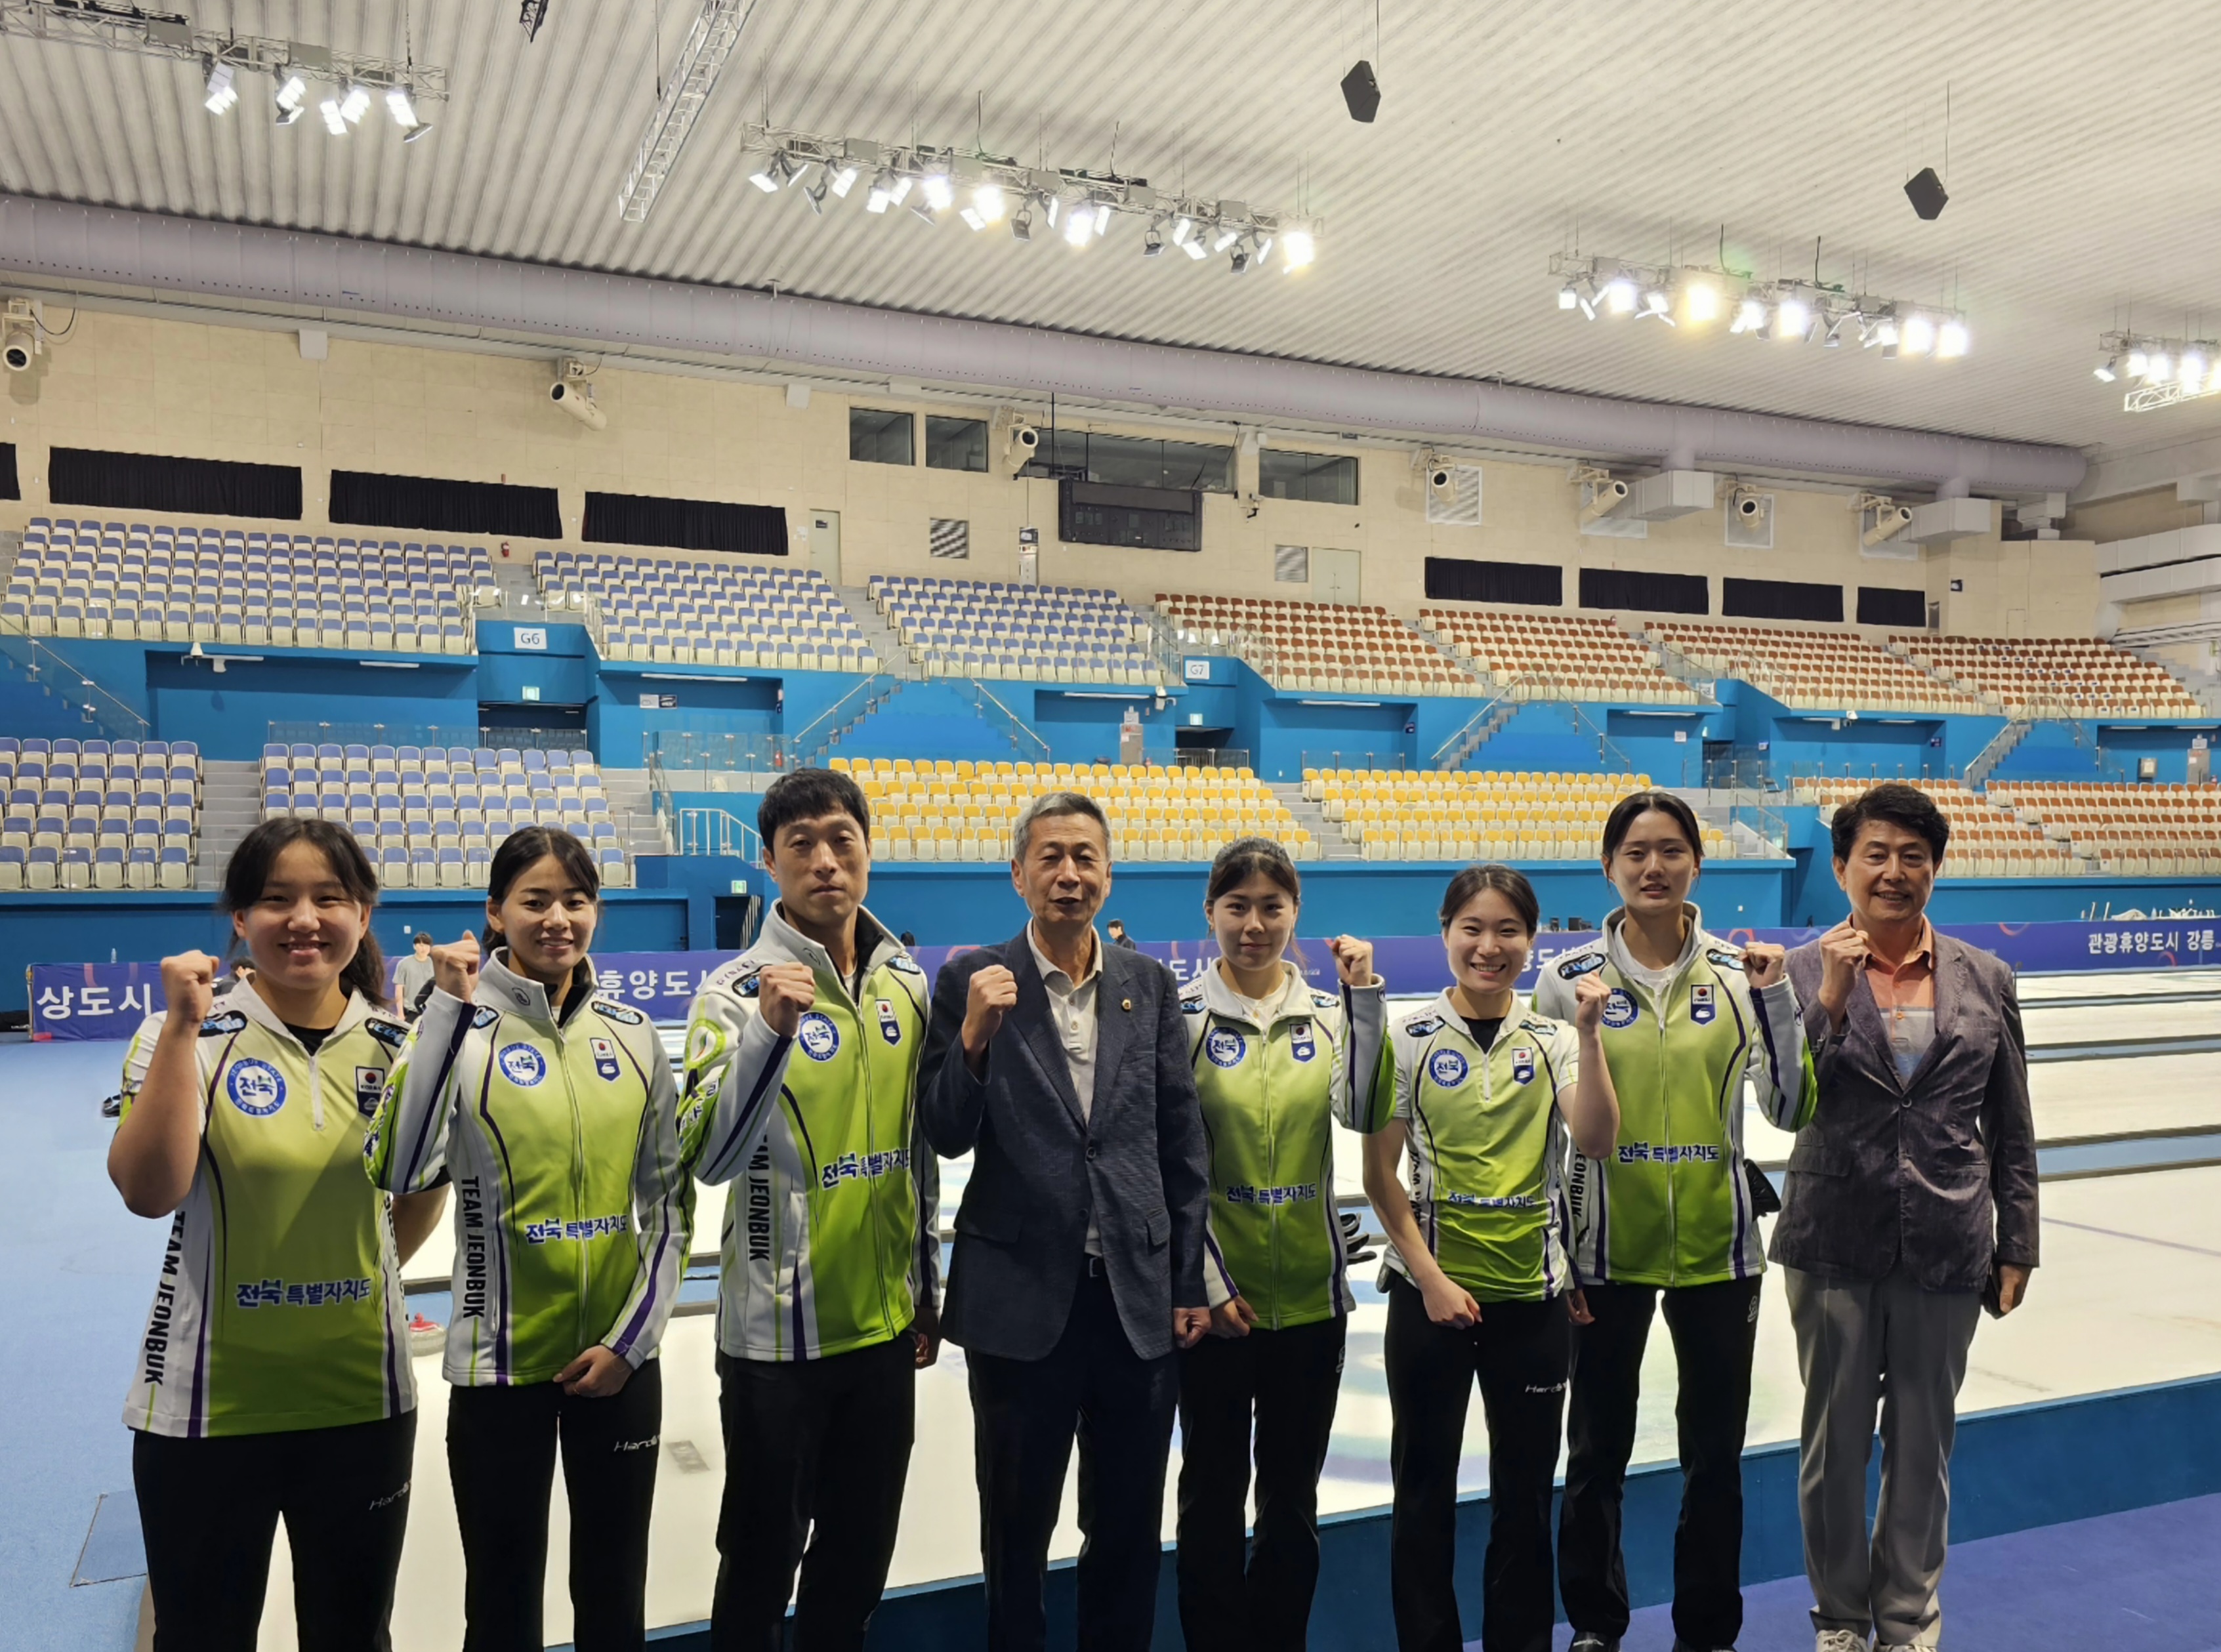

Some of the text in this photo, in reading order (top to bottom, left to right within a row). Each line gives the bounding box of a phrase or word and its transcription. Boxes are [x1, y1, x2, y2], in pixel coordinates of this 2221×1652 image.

[521, 632, 540, 645] G6
[1190, 665, 1204, 674] G7
[2088, 930, 2214, 954] 관광휴양도시 강릉
[37, 983, 152, 1019] 상도시
[239, 1075, 275, 1096] 전북
[1618, 1142, 1649, 1163] 전북
[821, 1153, 859, 1188] 전북
[1226, 1185, 1256, 1203] 전북
[526, 1215, 627, 1243] 전북 특별자치도
[748, 1176, 770, 1261] JEONBUK
[461, 1176, 486, 1319] TEAM JEONBUK
[145, 1210, 186, 1386] TEAM JEONBUK
[237, 1278, 371, 1307] 전북 특별자치도
